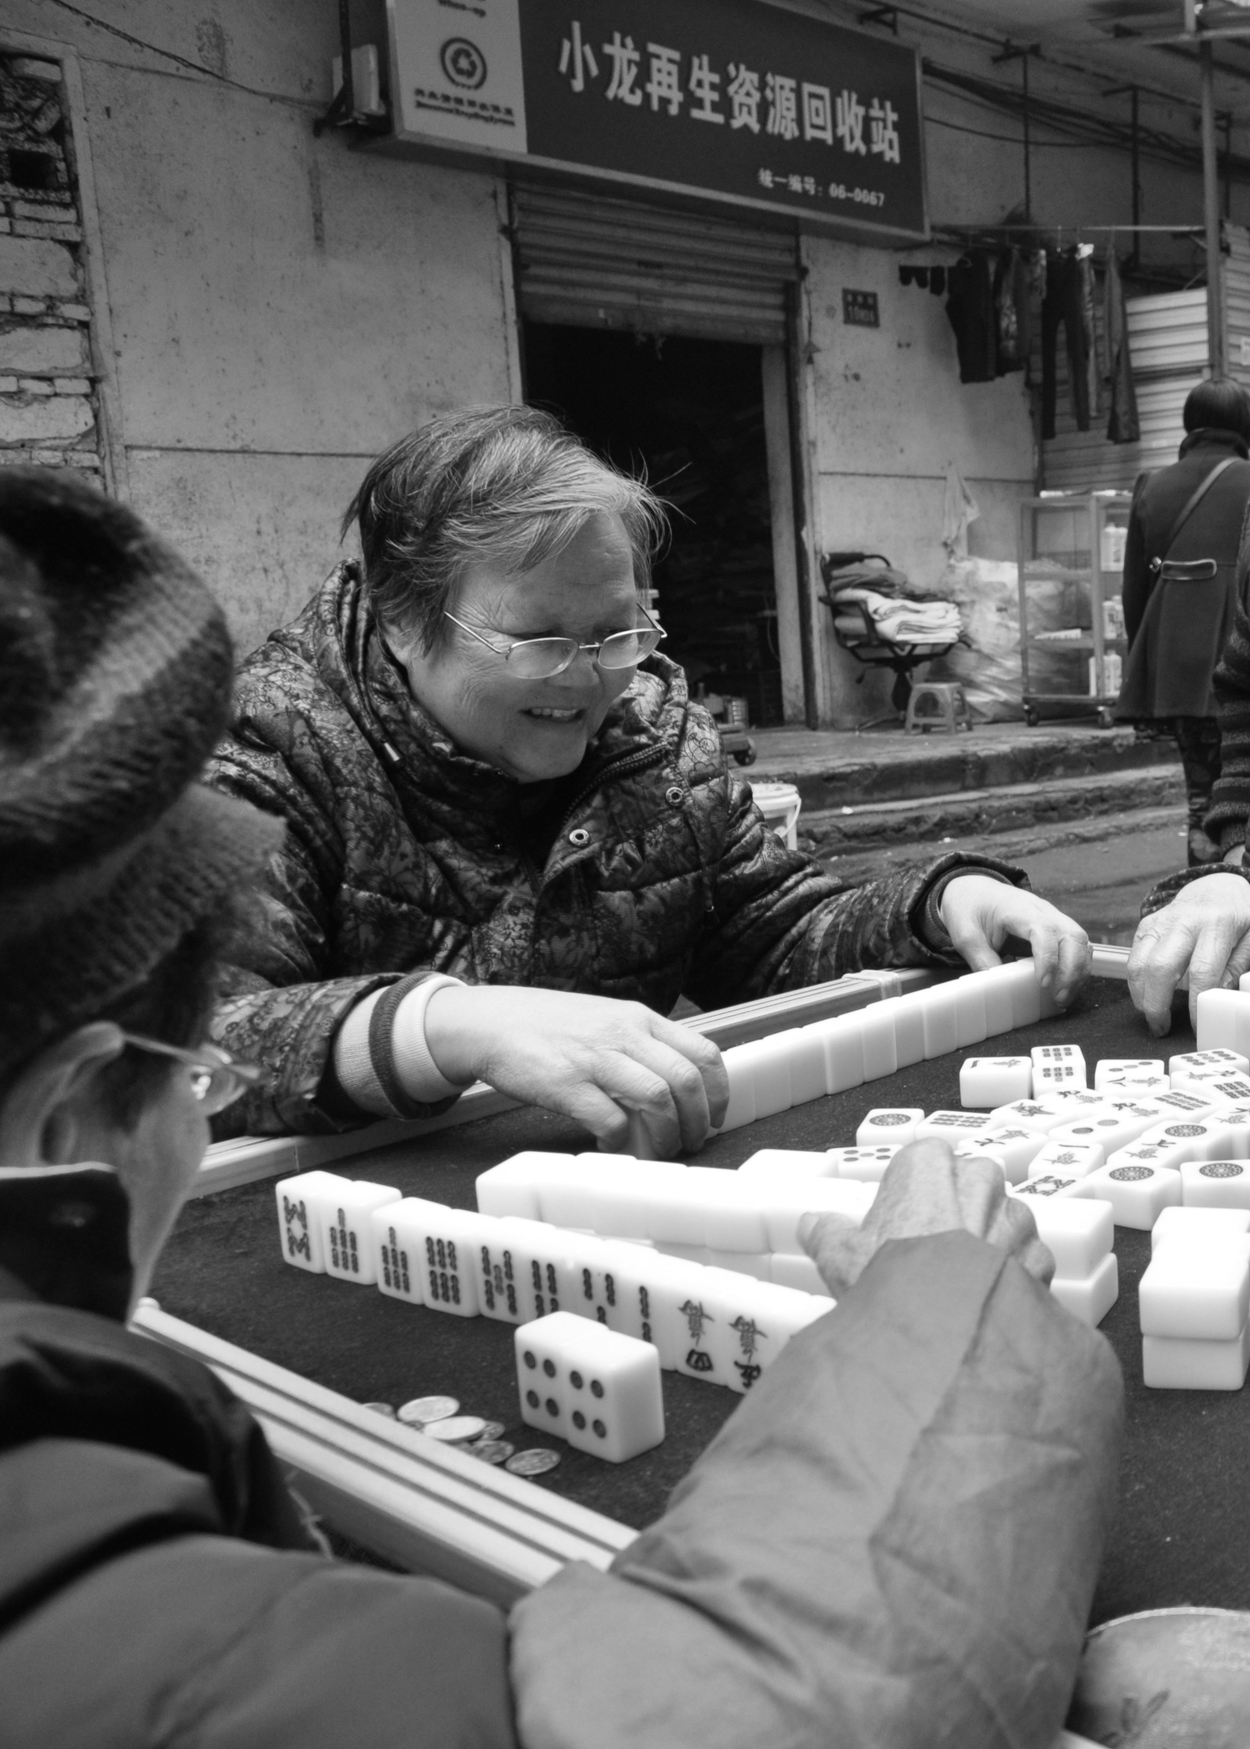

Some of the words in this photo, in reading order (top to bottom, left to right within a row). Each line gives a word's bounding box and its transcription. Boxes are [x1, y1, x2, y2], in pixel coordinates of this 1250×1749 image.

[558, 20, 900, 164] 小龙再生资源回收站
